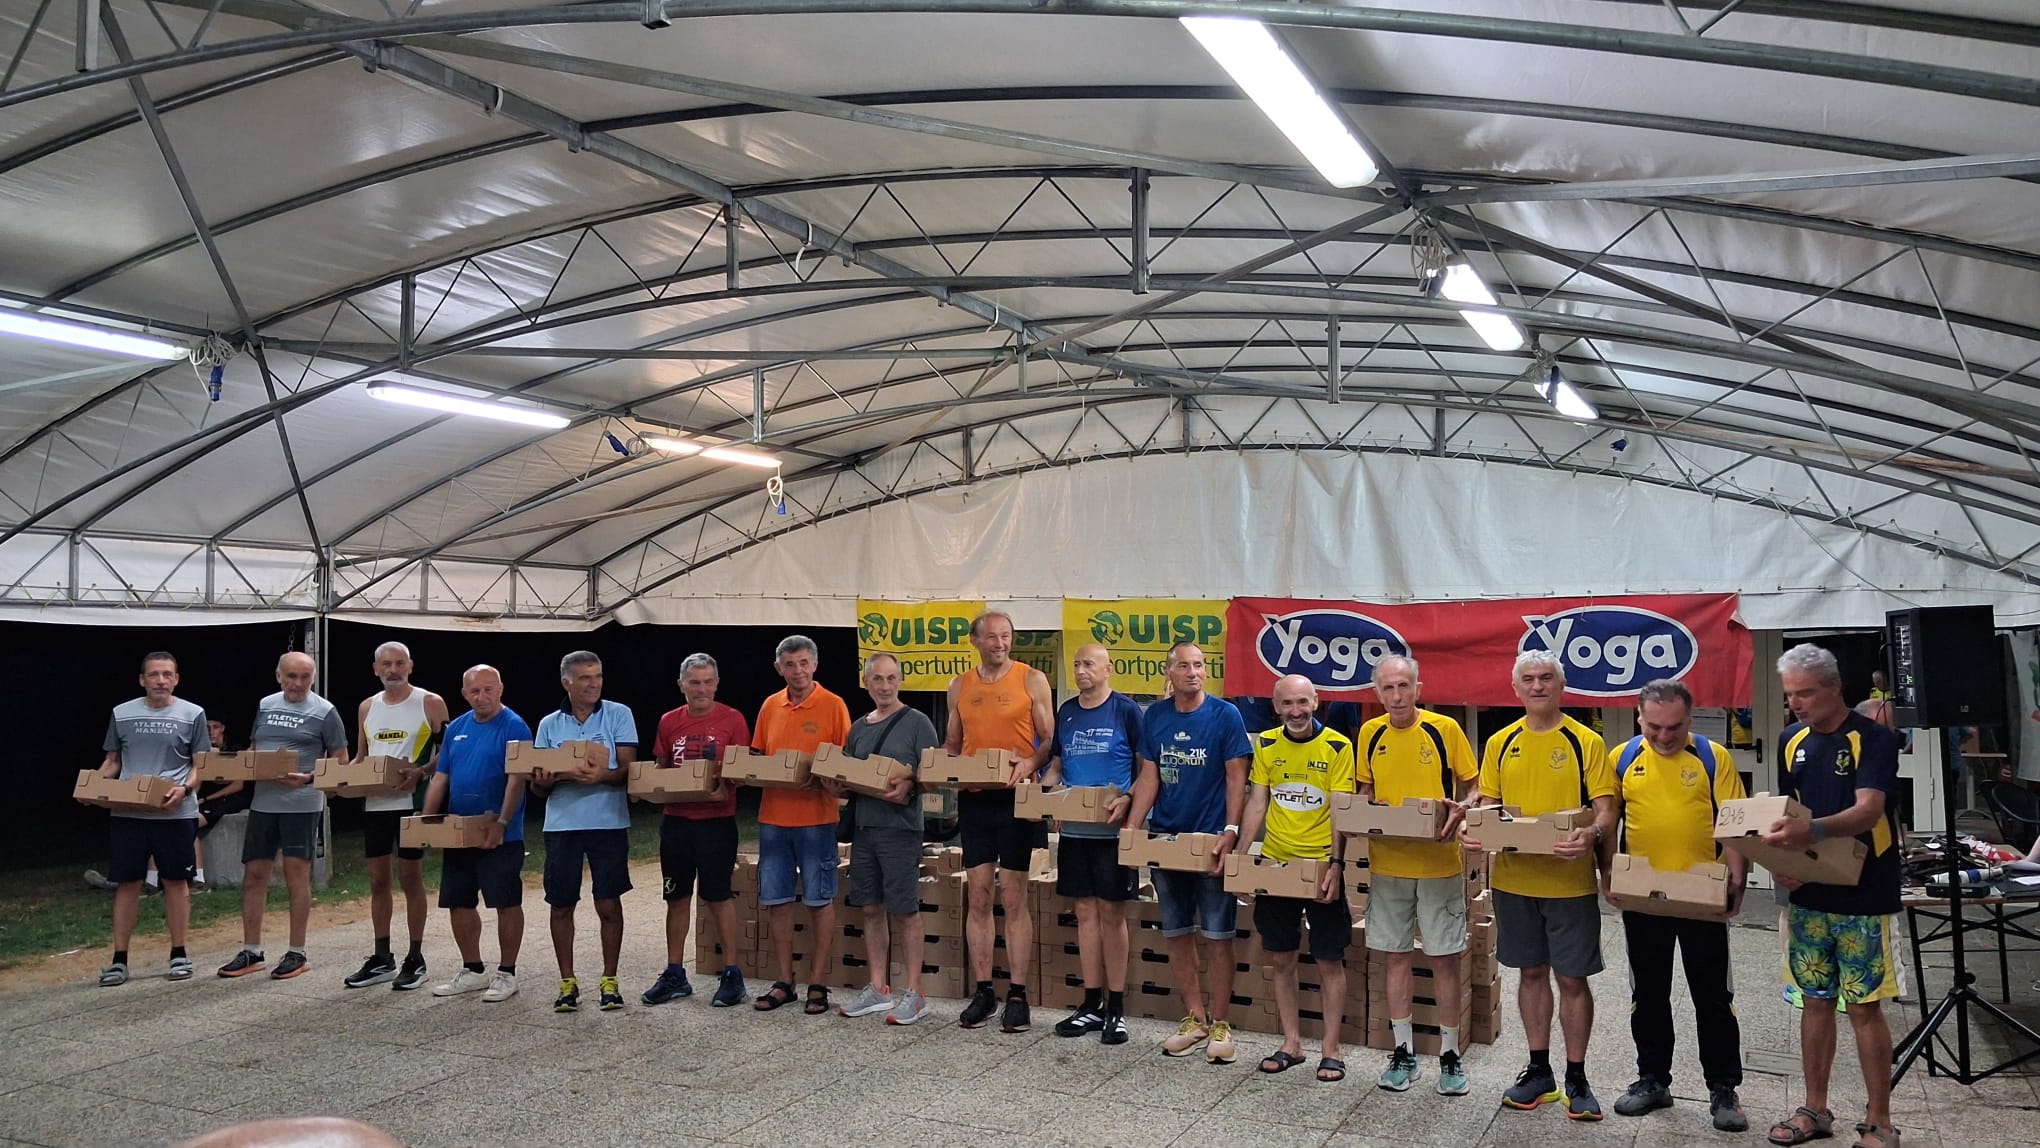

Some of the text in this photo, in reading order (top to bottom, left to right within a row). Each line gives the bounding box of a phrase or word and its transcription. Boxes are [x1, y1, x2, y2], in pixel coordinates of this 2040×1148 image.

[891, 616, 970, 647] UISP
[1129, 614, 1223, 645] UISP
[1271, 617, 1392, 682] Yoga
[1532, 617, 1679, 685] Yoga
[134, 721, 178, 730] ATLETICA
[1189, 748, 1208, 758] 21K
